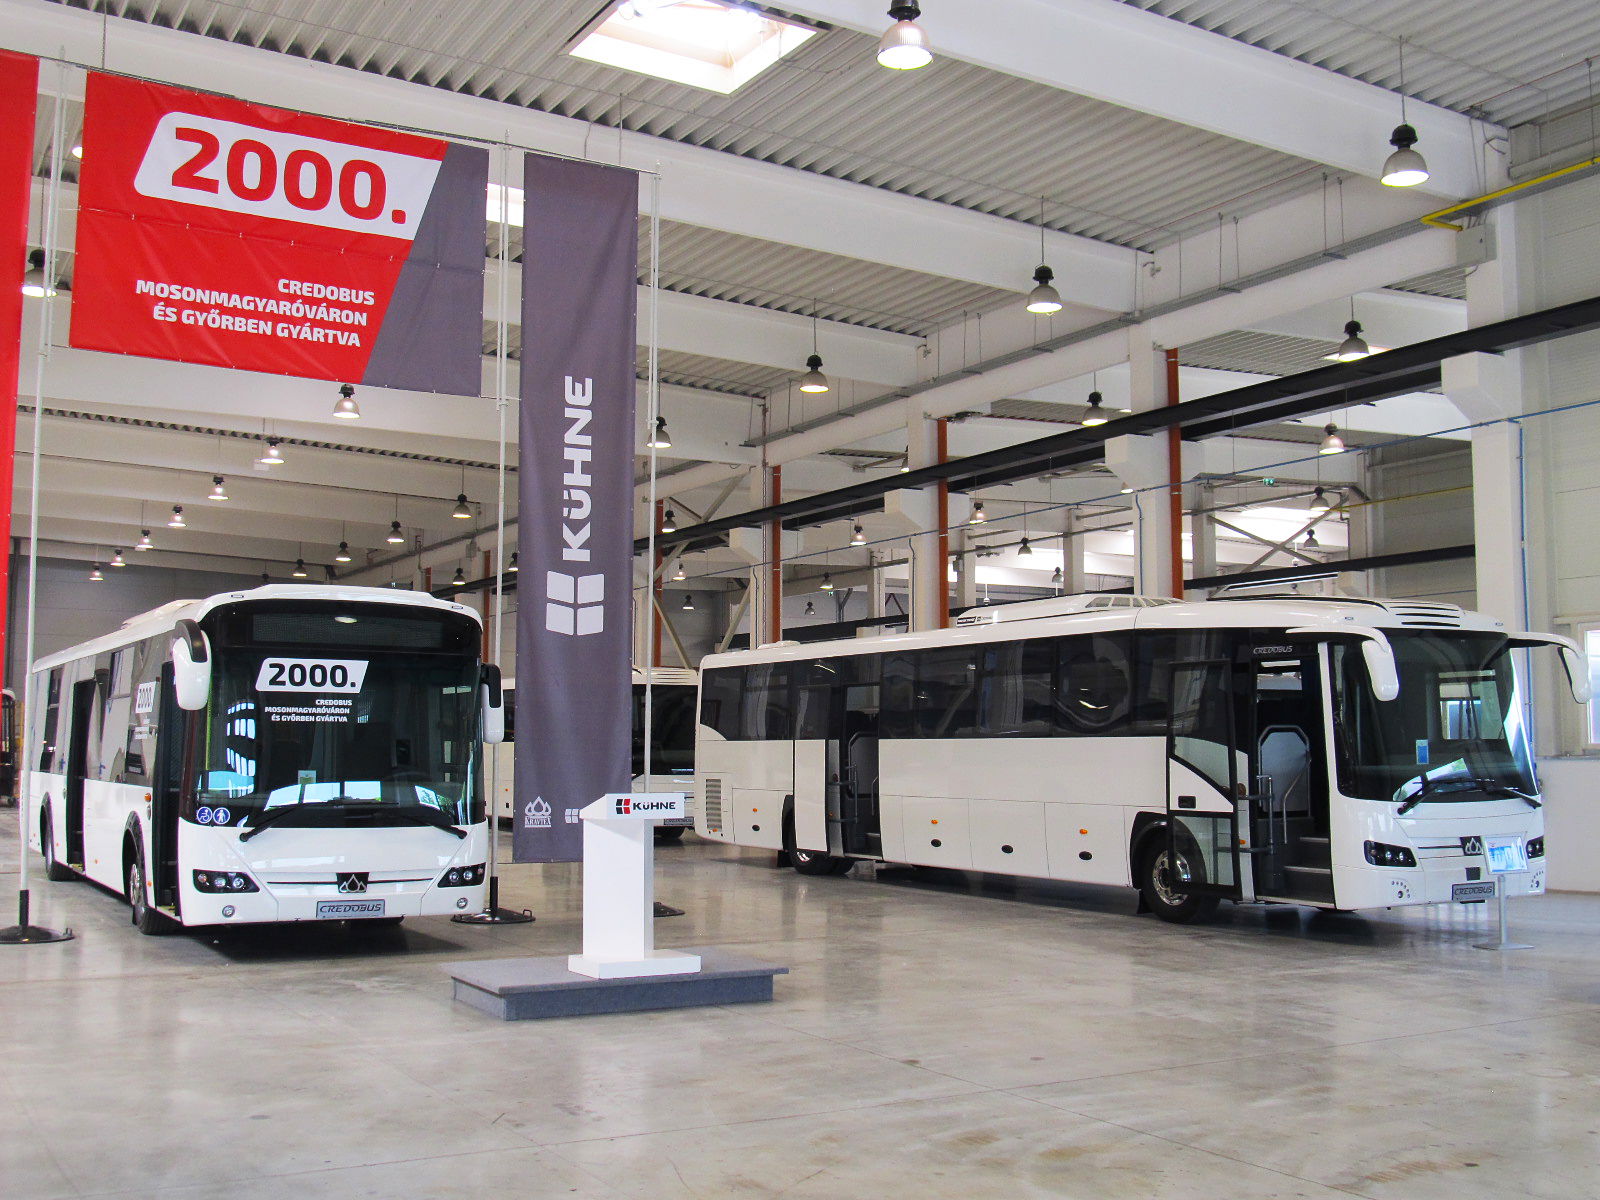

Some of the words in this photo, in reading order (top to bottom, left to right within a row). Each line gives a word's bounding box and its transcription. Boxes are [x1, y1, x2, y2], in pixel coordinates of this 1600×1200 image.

[171, 126, 407, 225] 2000.
[135, 279, 368, 326] MOSONMAGYARÓVÁRON
[277, 278, 375, 306] CREDOBUS
[152, 302, 178, 322] ÉS
[181, 309, 273, 335] GYŐRBEN
[276, 323, 361, 347] GYÁRTVA
[562, 375, 593, 562] KÜHNE
[268, 663, 357, 688] 2000.
[264, 706, 350, 714] MOSONMAGYARÓVÁRON
[271, 714, 281, 722] ÉS
[281, 714, 315, 722] GYŐRBEN
[315, 714, 348, 723] GYÁRTVA
[633, 801, 676, 811] KÜHNE
[1454, 887, 1493, 896] CREDOBUS
[319, 903, 382, 913] CREDOBUS
